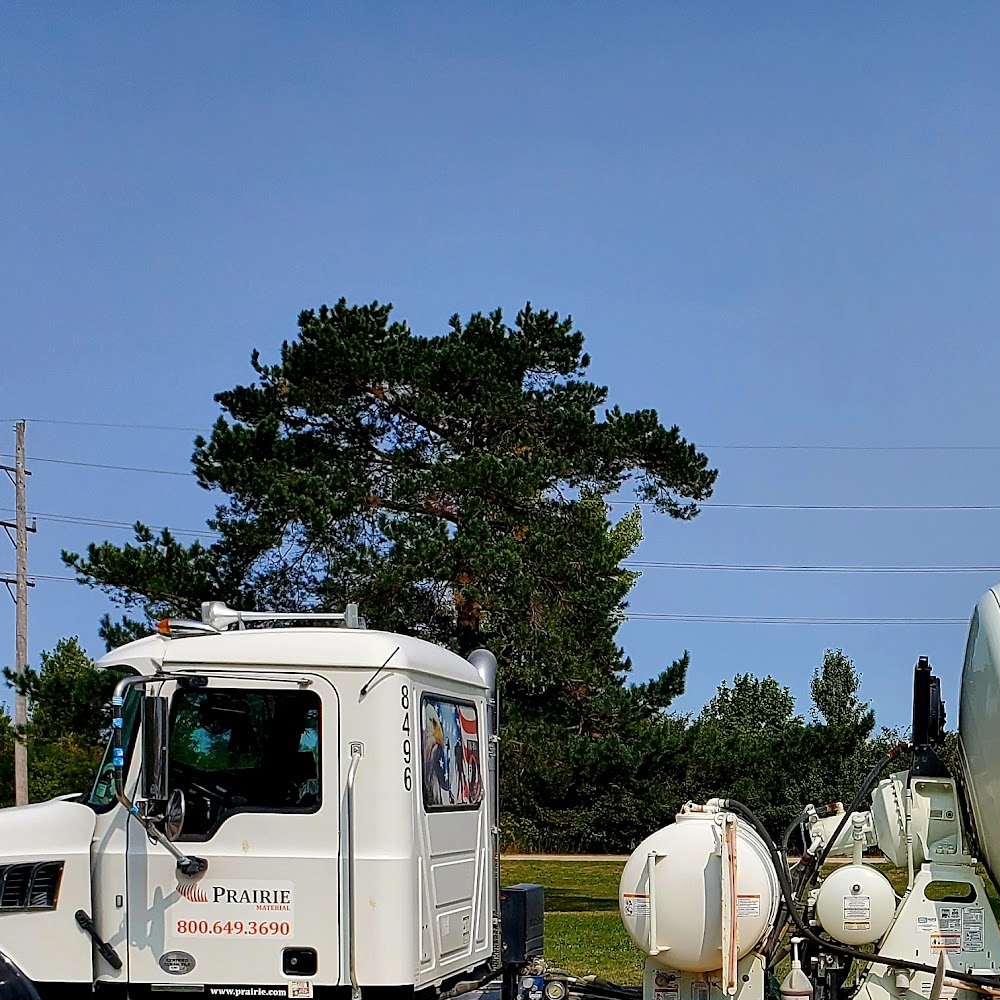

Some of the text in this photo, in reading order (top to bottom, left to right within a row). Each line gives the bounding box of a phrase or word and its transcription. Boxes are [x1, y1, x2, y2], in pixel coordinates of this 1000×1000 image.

[401, 685, 412, 791] 8496
[212, 886, 291, 904] PRAIRIE
[177, 920, 290, 936] 800.649.3690
[210, 987, 287, 997] www.prairie.com
